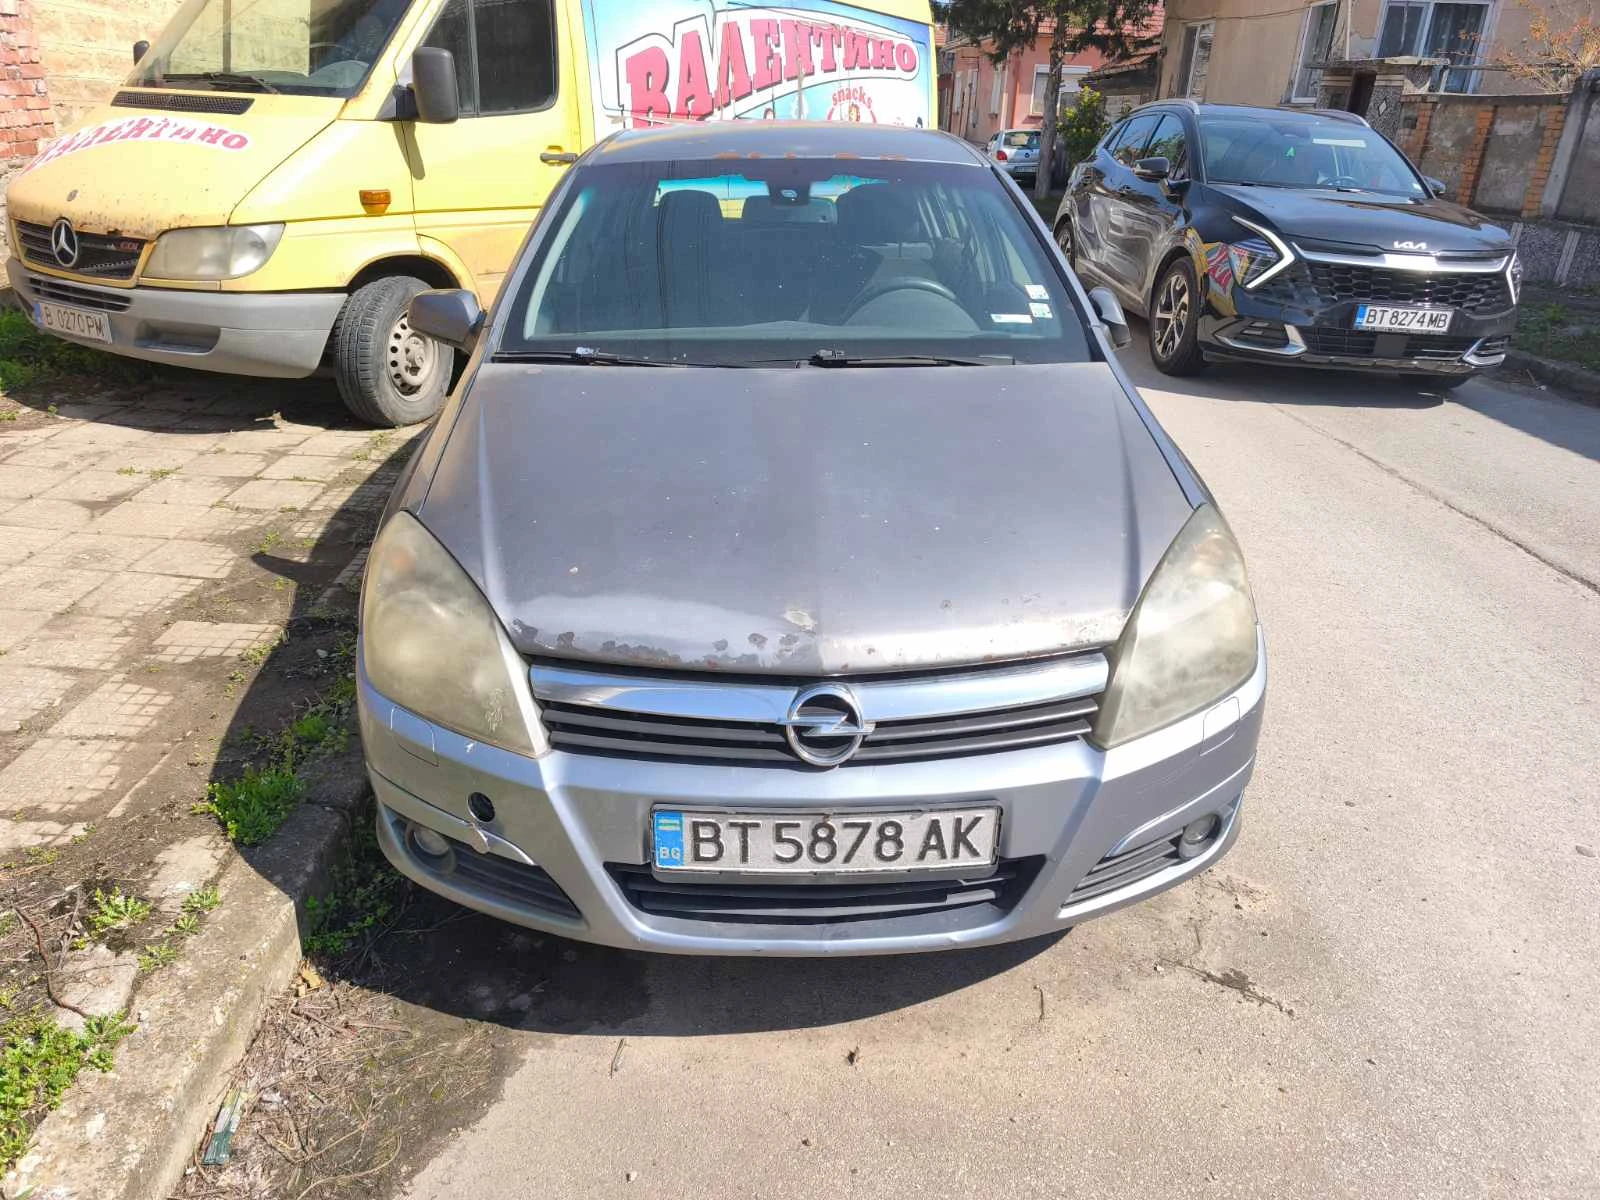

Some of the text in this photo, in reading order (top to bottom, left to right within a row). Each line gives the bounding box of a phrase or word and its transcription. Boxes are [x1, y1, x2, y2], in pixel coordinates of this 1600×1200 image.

[626, 19, 917, 128] ВАЛЕНТИНО
[832, 86, 872, 109] snacks
[1366, 308, 1448, 329] BT 8274 MB
[691, 815, 985, 865] BT 5878 AK
[659, 846, 681, 859] BG
